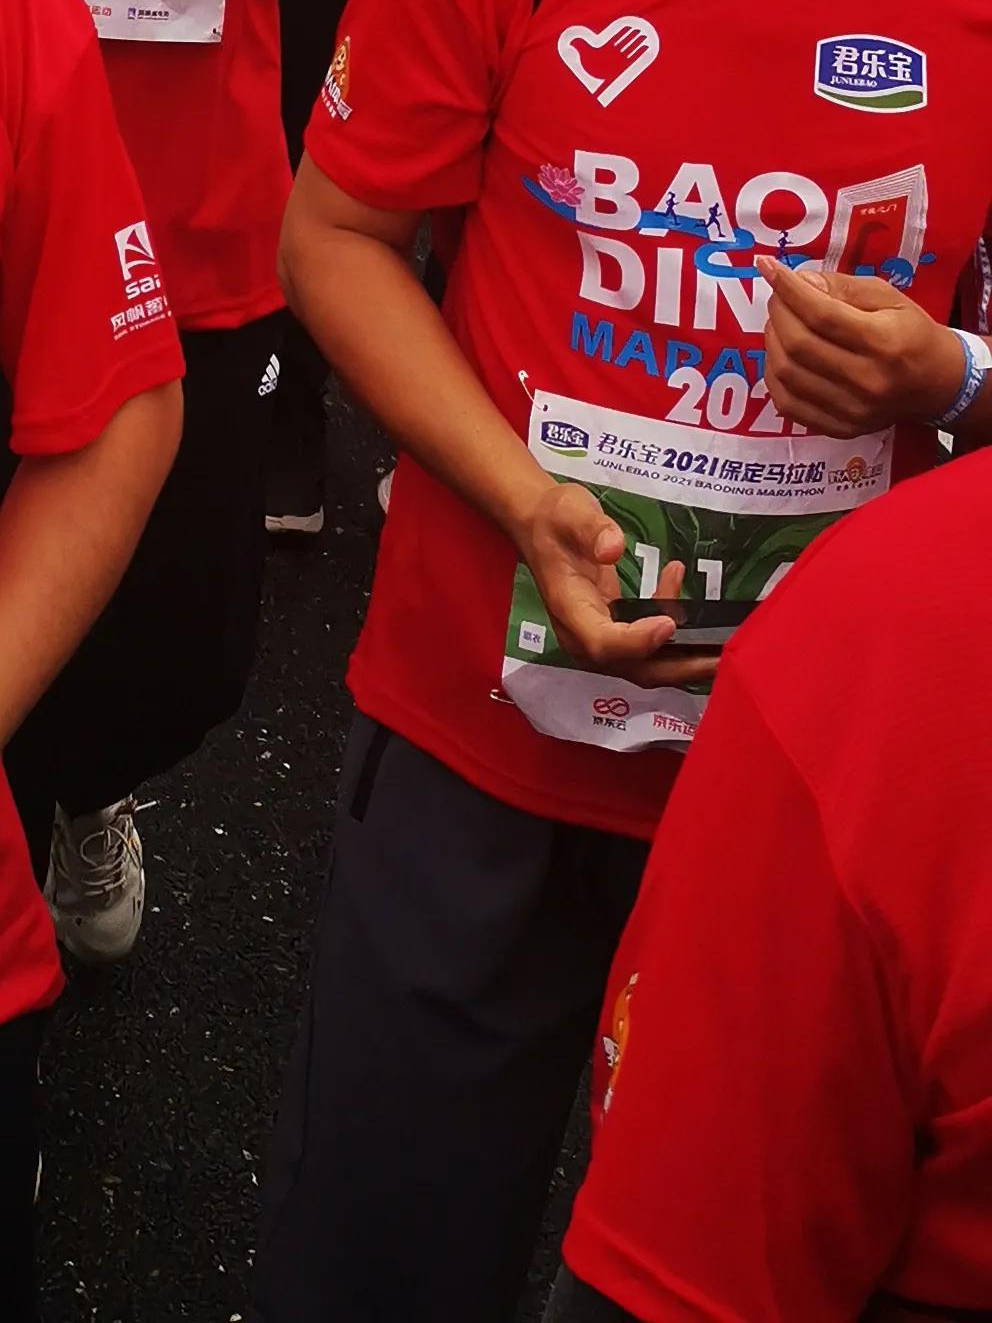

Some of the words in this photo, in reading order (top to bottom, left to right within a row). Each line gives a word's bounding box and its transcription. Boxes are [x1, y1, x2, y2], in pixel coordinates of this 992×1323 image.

[830, 74, 878, 88] JUNLEBAO
[832, 44, 914, 82] 君乐宝
[574, 149, 829, 248] BAO
[125, 274, 161, 299] sai
[577, 231, 794, 333] DIN
[570, 311, 767, 389] MARAT
[665, 366, 808, 435] 202
[593, 457, 661, 480] JUNLEBAO
[663, 474, 693, 488] 2021
[694, 479, 756, 498] BAODING
[756, 485, 826, 497] MARATHON
[596, 431, 827, 486] 君乐宝2021保定马拉松
[652, 713, 698, 738] 京东运
